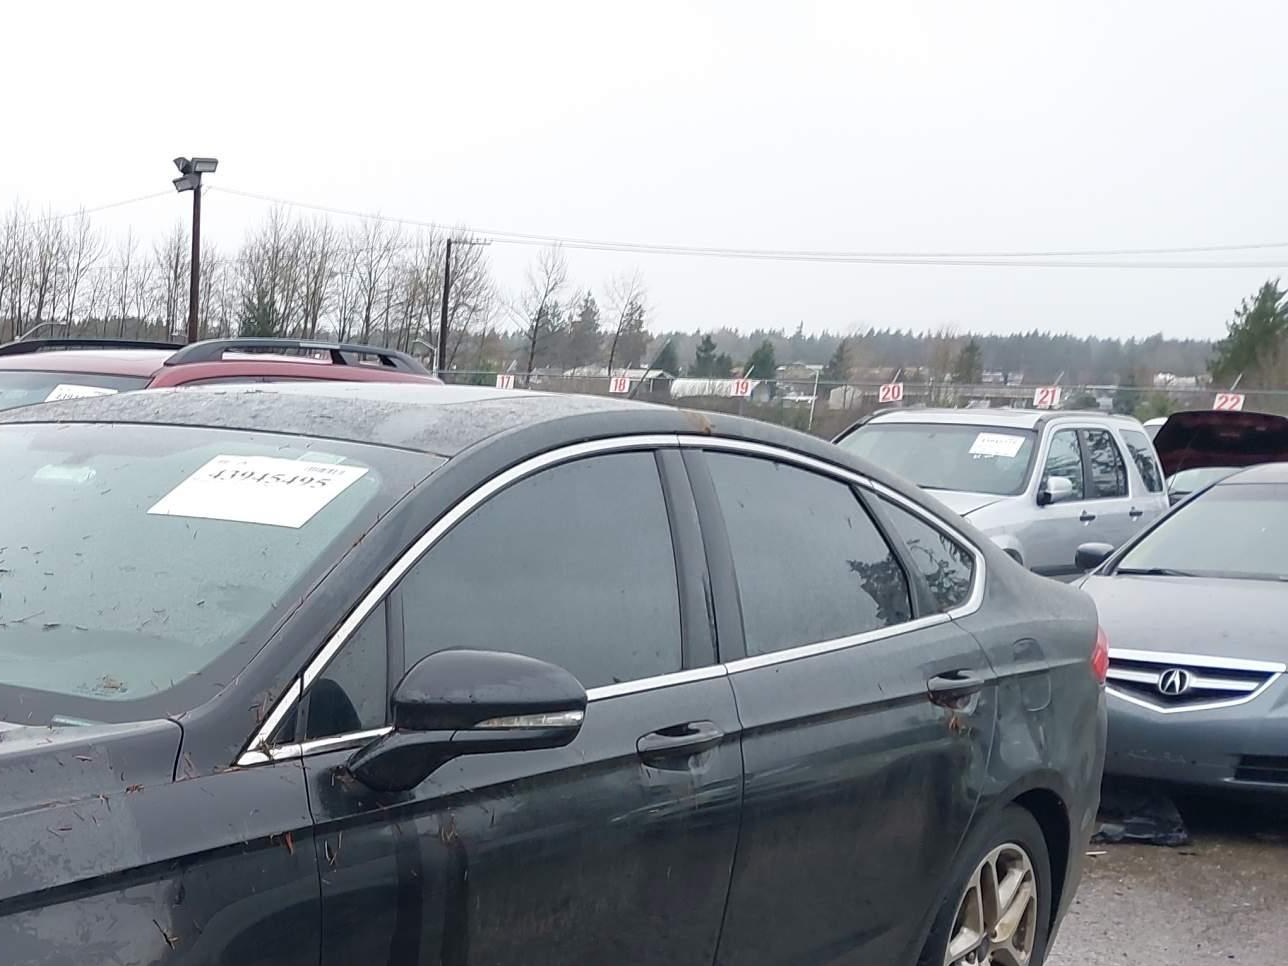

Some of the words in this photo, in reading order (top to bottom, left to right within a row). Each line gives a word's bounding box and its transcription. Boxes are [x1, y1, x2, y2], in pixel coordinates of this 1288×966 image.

[500, 375, 511, 389] 17
[614, 378, 627, 391] 18
[735, 381, 749, 395] 19
[882, 385, 901, 400] 20
[1038, 389, 1057, 405] 21
[1217, 394, 1241, 410] 22
[209, 468, 332, 489] 43945495
